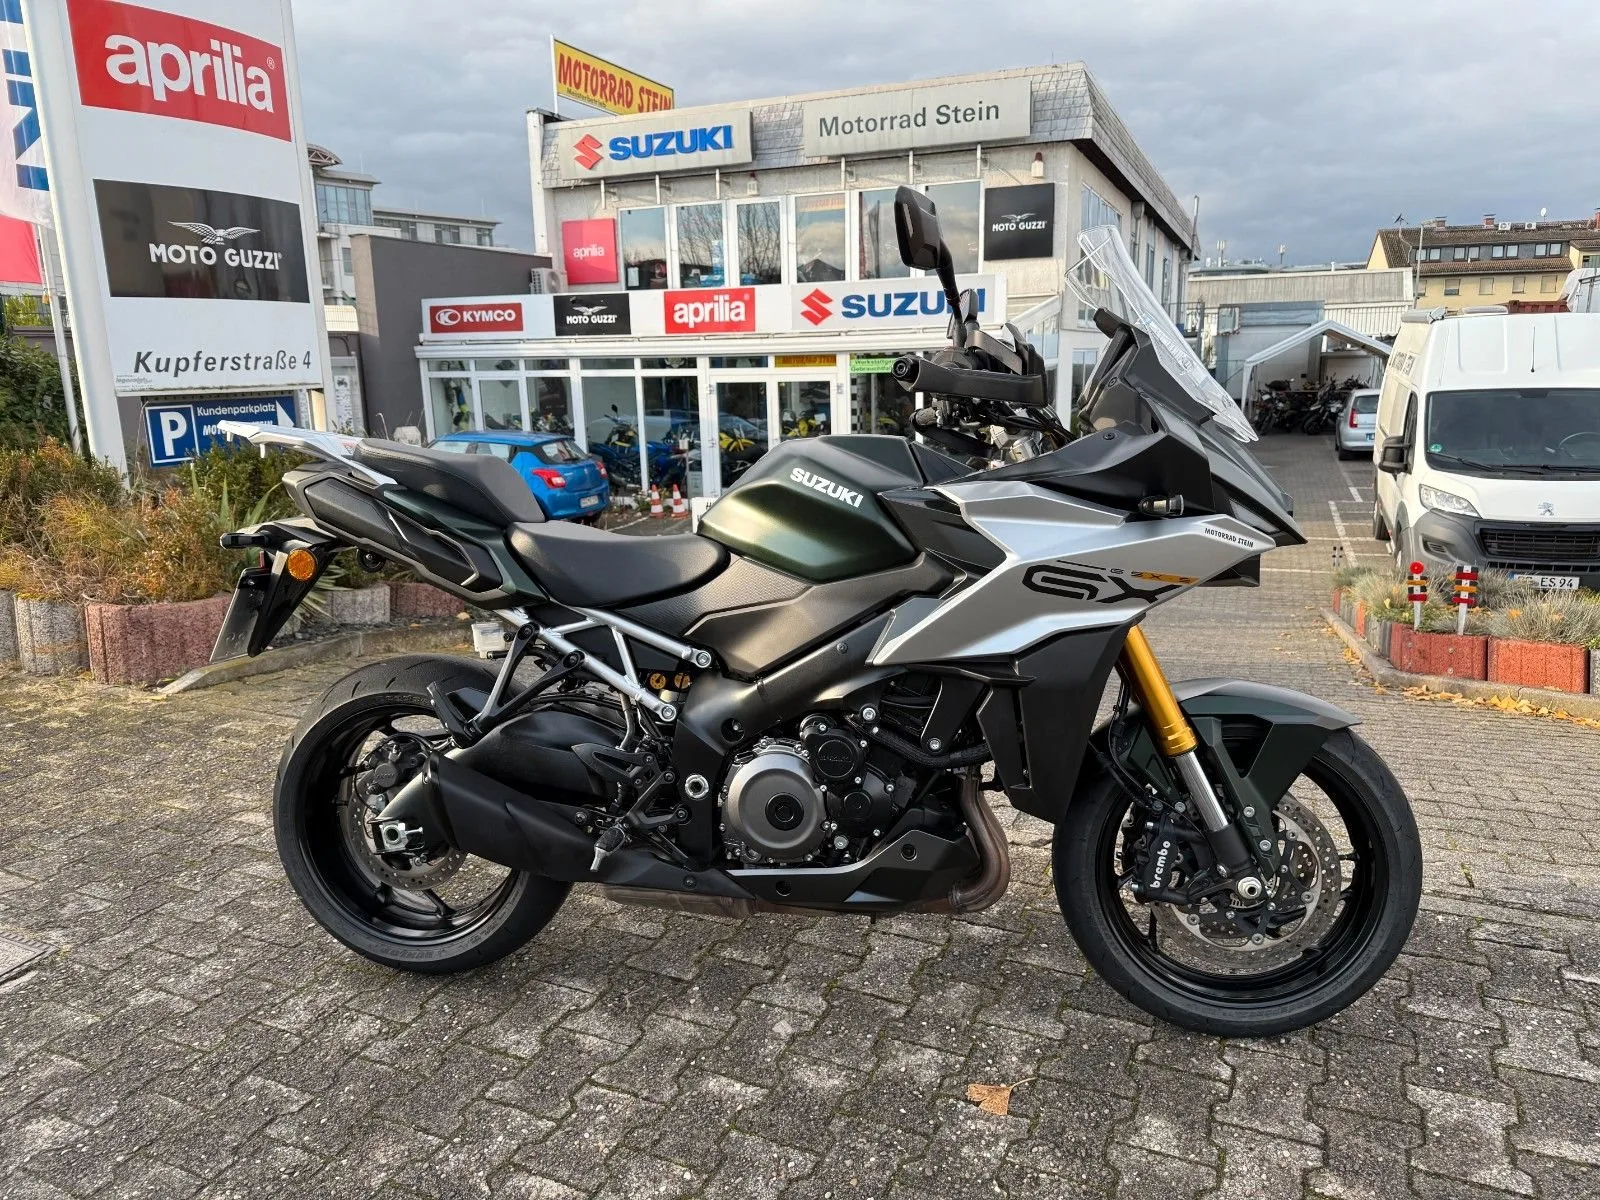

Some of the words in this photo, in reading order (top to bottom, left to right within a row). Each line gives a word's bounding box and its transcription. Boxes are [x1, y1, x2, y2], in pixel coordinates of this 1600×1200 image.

[104, 34, 274, 113] aprilia
[558, 53, 634, 109] MOTORRAD
[819, 107, 927, 137] Motorrad
[936, 100, 1000, 125] Stein
[609, 124, 733, 161] SUZUKI
[992, 222, 1016, 232] MOTO
[1018, 220, 1045, 231] GUZZI
[149, 243, 216, 266] MOTO
[224, 248, 280, 271] GUZZI
[573, 243, 605, 258] aprilia
[463, 309, 516, 323] KYMCO
[673, 294, 746, 328] aprilia
[841, 288, 986, 319] SUZUI
[566, 315, 589, 325] MOTO
[591, 313, 617, 324] GUZZI
[133, 350, 297, 378] Kupferstraße
[302, 350, 312, 369] 4
[196, 403, 276, 417] Kundenparkplatz
[159, 411, 187, 457] P
[790, 467, 864, 508] SUZUKI
[1205, 528, 1237, 542] MOTORRAD
[1238, 537, 1254, 548] STEIN
[1540, 577, 1556, 587] ES
[1559, 578, 1573, 588] 94
[1150, 840, 1171, 888] brembo
